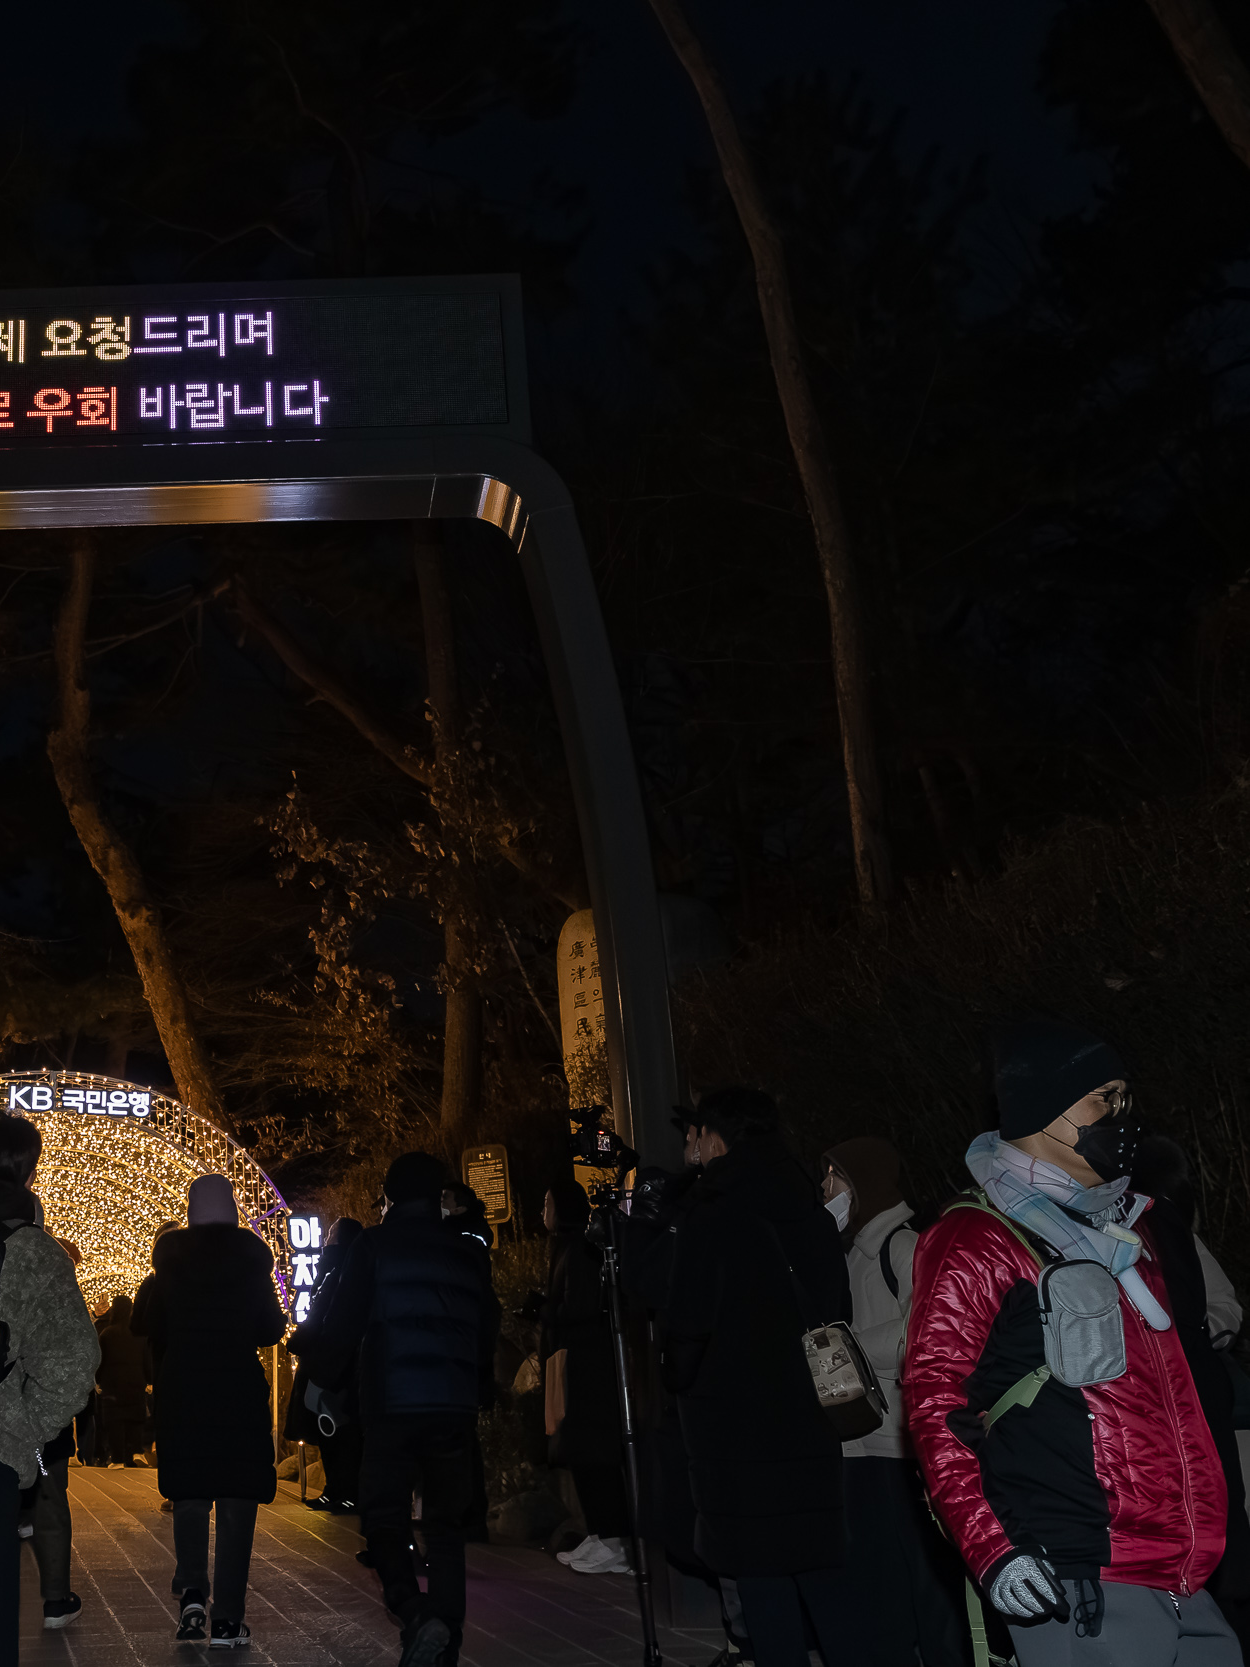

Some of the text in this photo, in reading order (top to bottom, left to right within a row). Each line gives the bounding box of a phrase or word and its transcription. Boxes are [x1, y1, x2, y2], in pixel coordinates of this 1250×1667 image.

[40, 311, 275, 361] 요청드리며
[26, 385, 118, 433] 우회
[138, 380, 330, 430] 바랍니다
[8, 1084, 151, 1118] KB 국민은행
